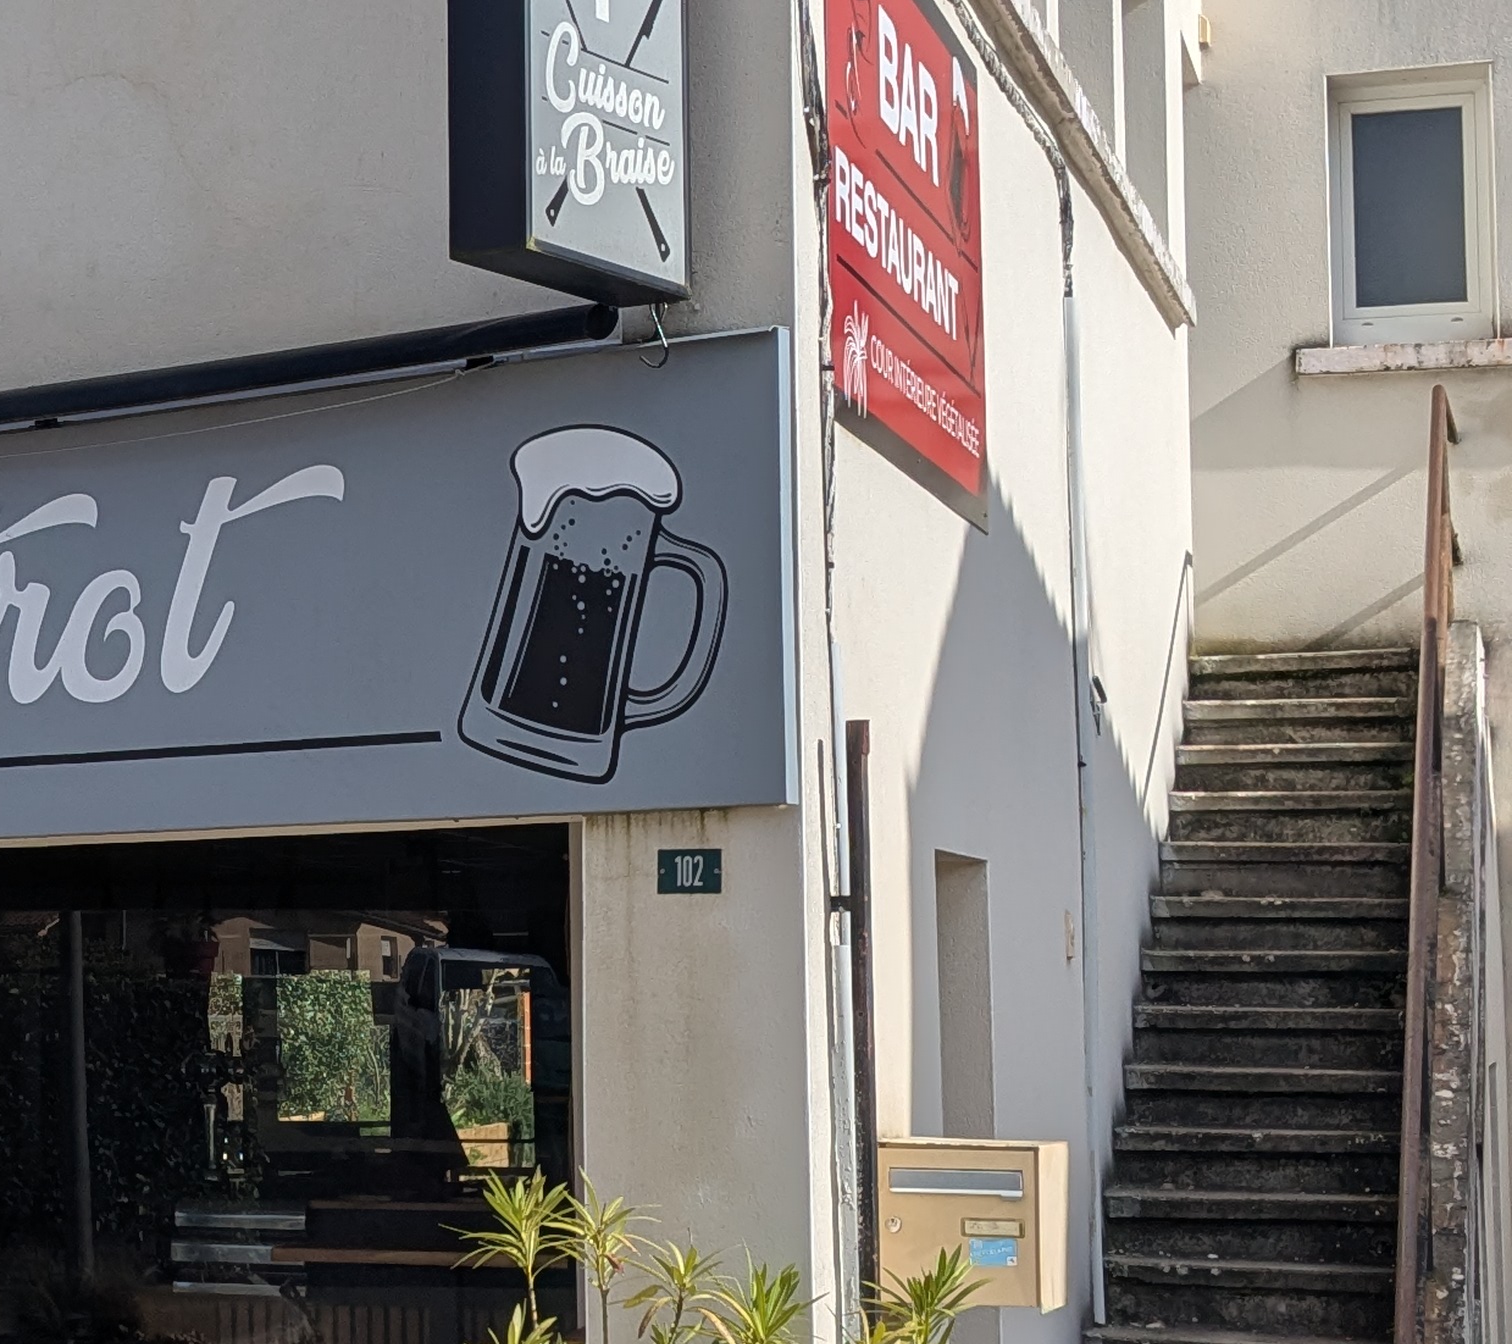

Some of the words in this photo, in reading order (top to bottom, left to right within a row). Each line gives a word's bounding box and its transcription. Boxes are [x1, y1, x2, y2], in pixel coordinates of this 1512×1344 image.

[545, 21, 666, 130] Cuisson
[878, 3, 940, 187] BAR
[536, 148, 548, 175] à
[549, 146, 567, 175] la
[560, 112, 675, 206] Braise
[834, 145, 959, 341] RESTAURANT
[870, 334, 894, 385] COUR
[894, 355, 938, 422] INTÉRIEURE
[937, 390, 980, 459] VÉGÉTALISÉE
[674, 855, 704, 887] 102
